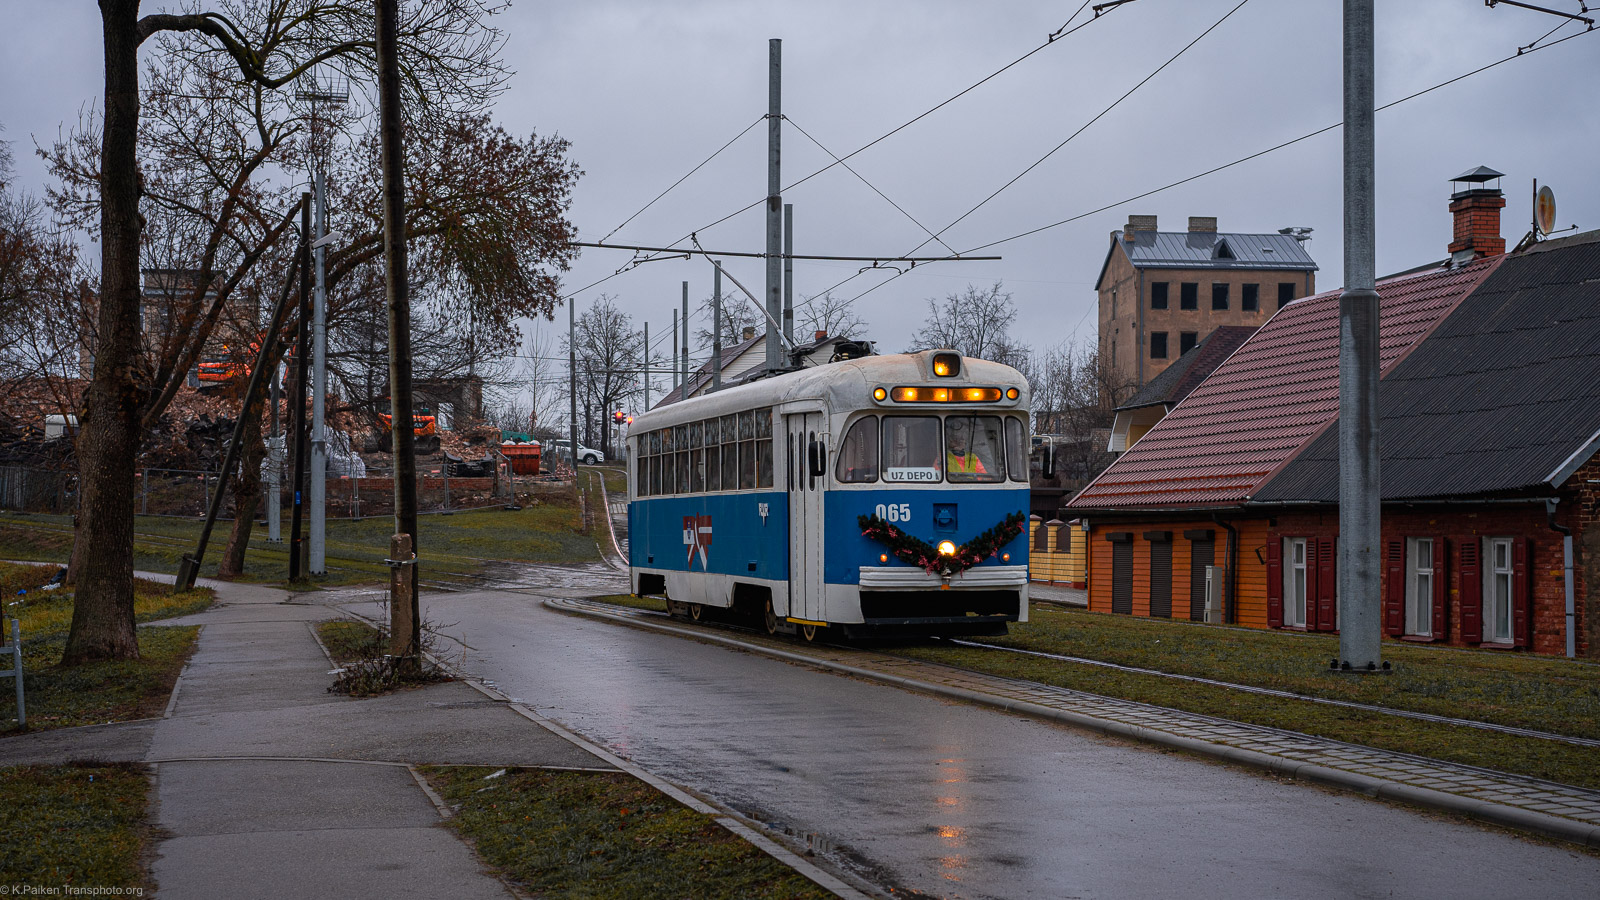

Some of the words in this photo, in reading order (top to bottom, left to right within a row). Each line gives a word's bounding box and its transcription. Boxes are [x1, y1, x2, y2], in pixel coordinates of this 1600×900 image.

[891, 471, 904, 480] UZ
[907, 471, 933, 480] DEPO
[875, 503, 911, 522] 065
